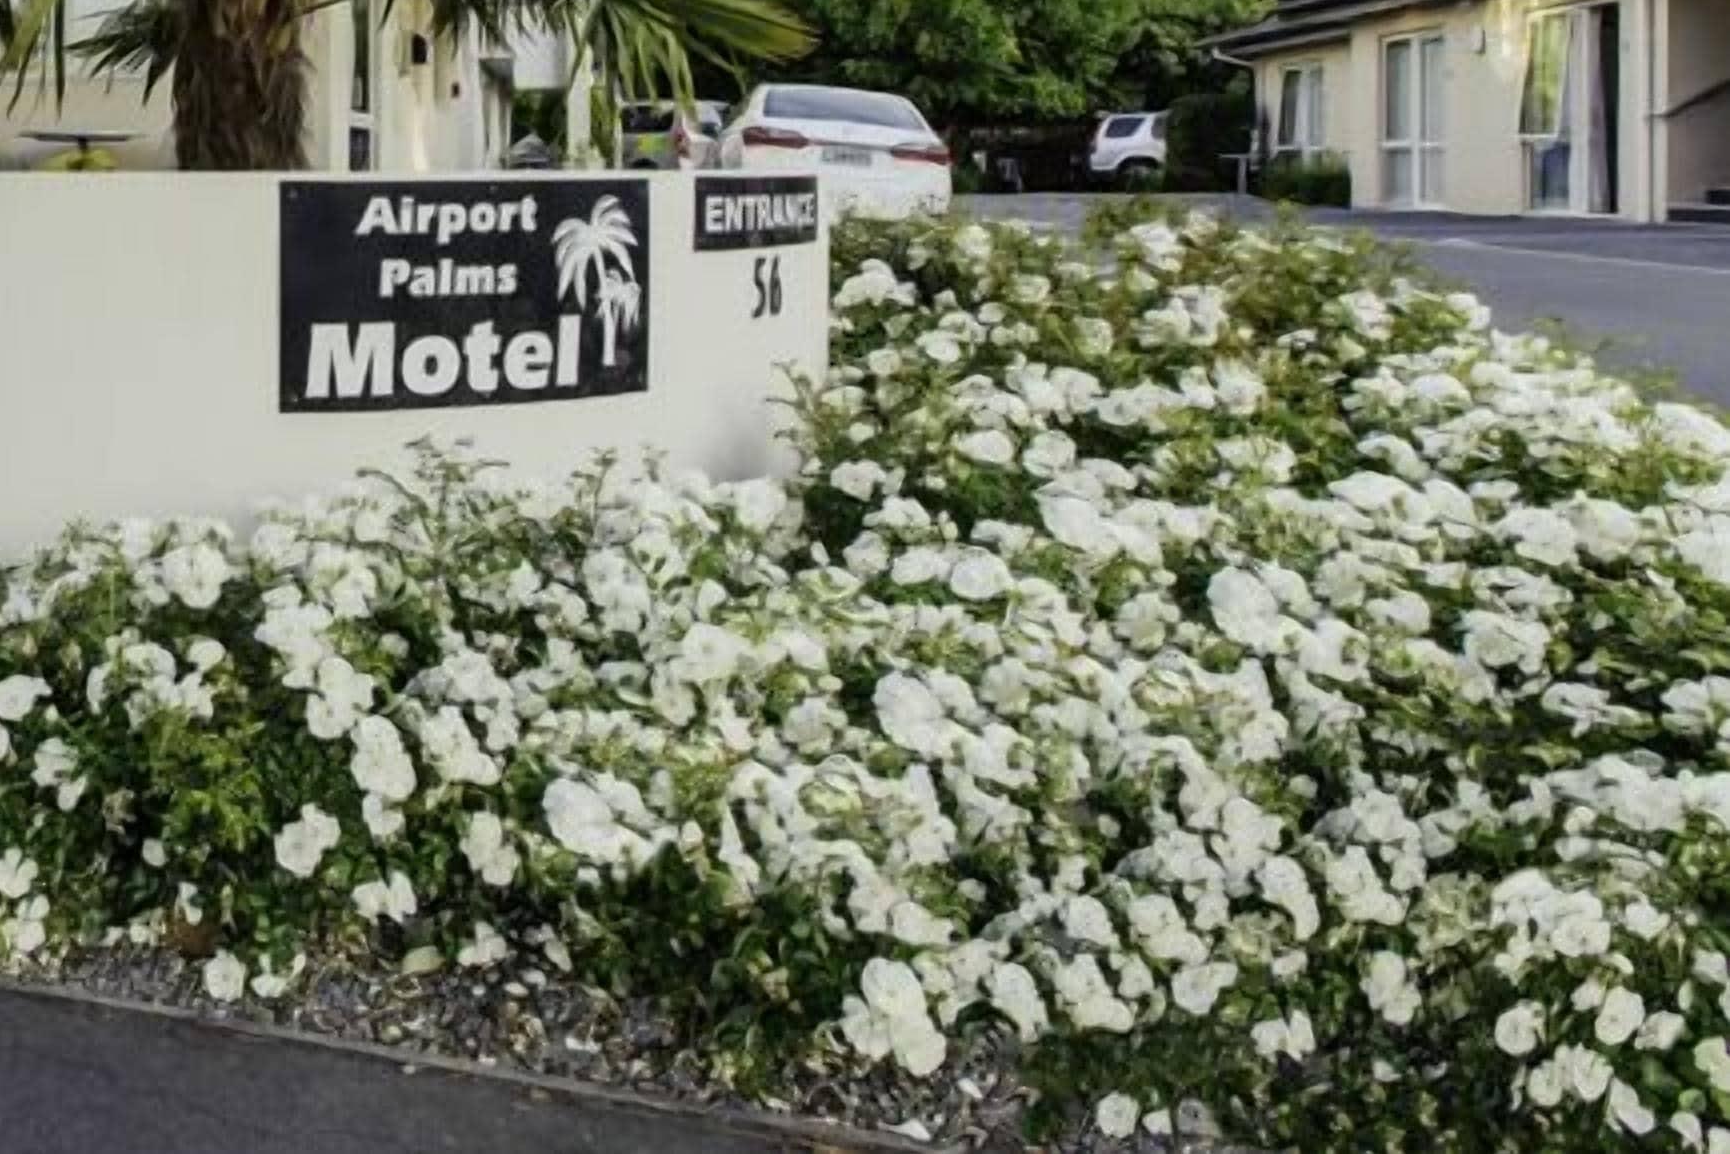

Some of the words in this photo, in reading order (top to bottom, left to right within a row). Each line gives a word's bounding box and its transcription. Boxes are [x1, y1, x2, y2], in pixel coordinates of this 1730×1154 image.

[355, 194, 537, 244] Airport
[705, 193, 815, 234] ENTRANCE
[378, 258, 518, 297] Palms
[751, 254, 783, 319] 56
[305, 314, 582, 399] Motel
